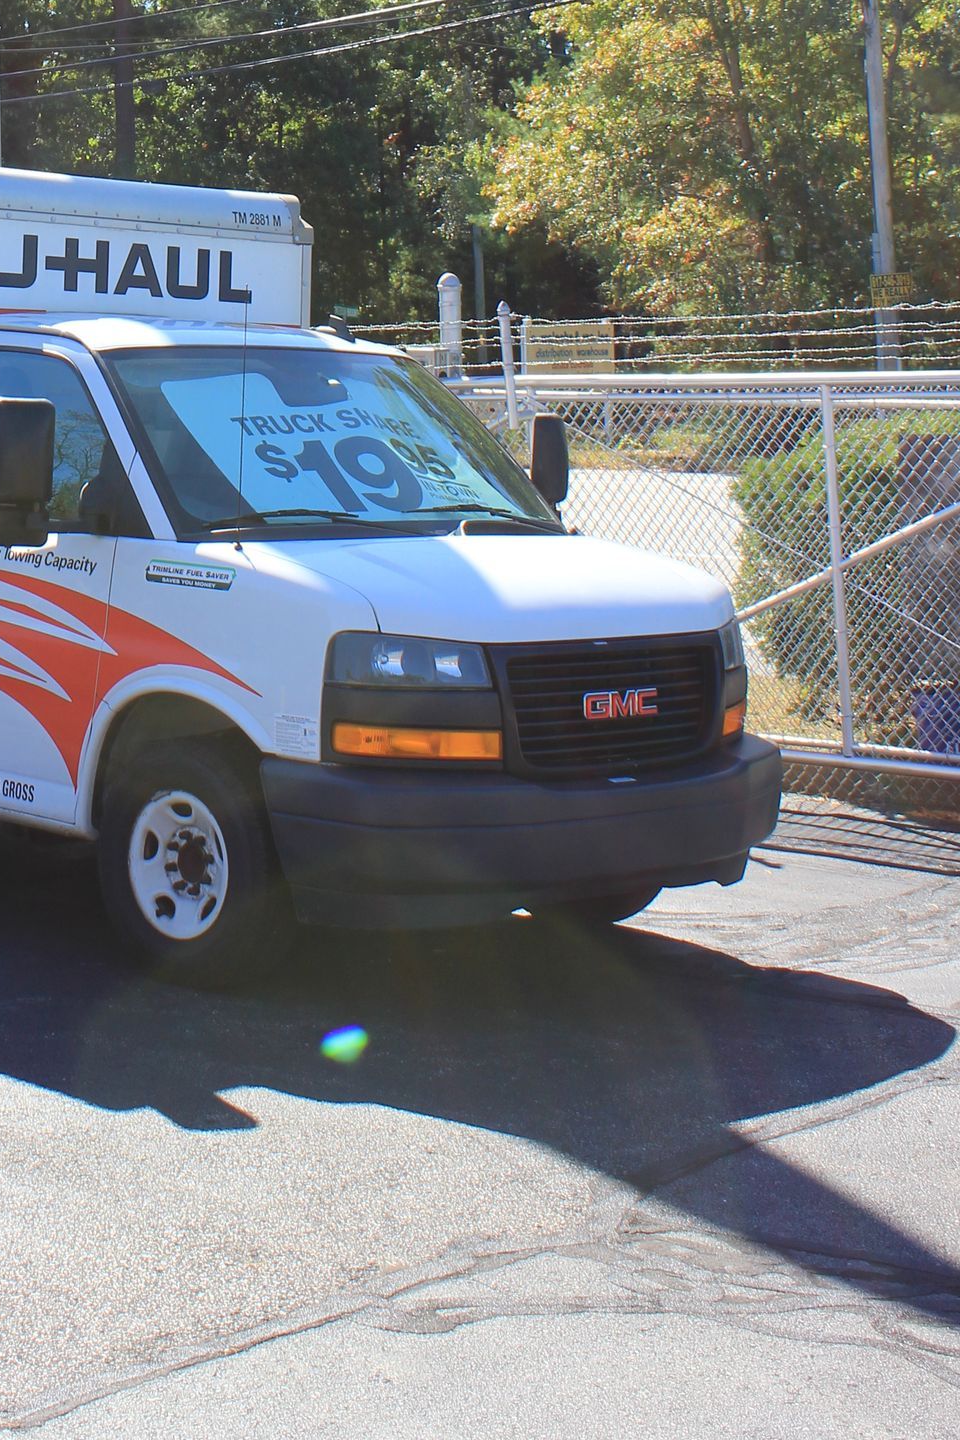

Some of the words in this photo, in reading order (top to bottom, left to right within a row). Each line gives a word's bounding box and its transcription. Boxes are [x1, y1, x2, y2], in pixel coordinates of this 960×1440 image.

[231, 211, 247, 225] TM
[249, 212, 270, 226] 2881
[272, 215, 282, 227] M
[230, 413, 336, 437] TRUCK
[336, 408, 421, 440] SHARE
[4, 546, 43, 569] Towing
[44, 551, 98, 576] Capacity
[152, 565, 184, 575] TRIMLINE
[186, 569, 204, 578] FUEL
[205, 571, 230, 581] SAVER
[194, 580, 216, 589] MONEY
[583, 687, 658, 719] GMC
[2, 779, 35, 803] GROSS
